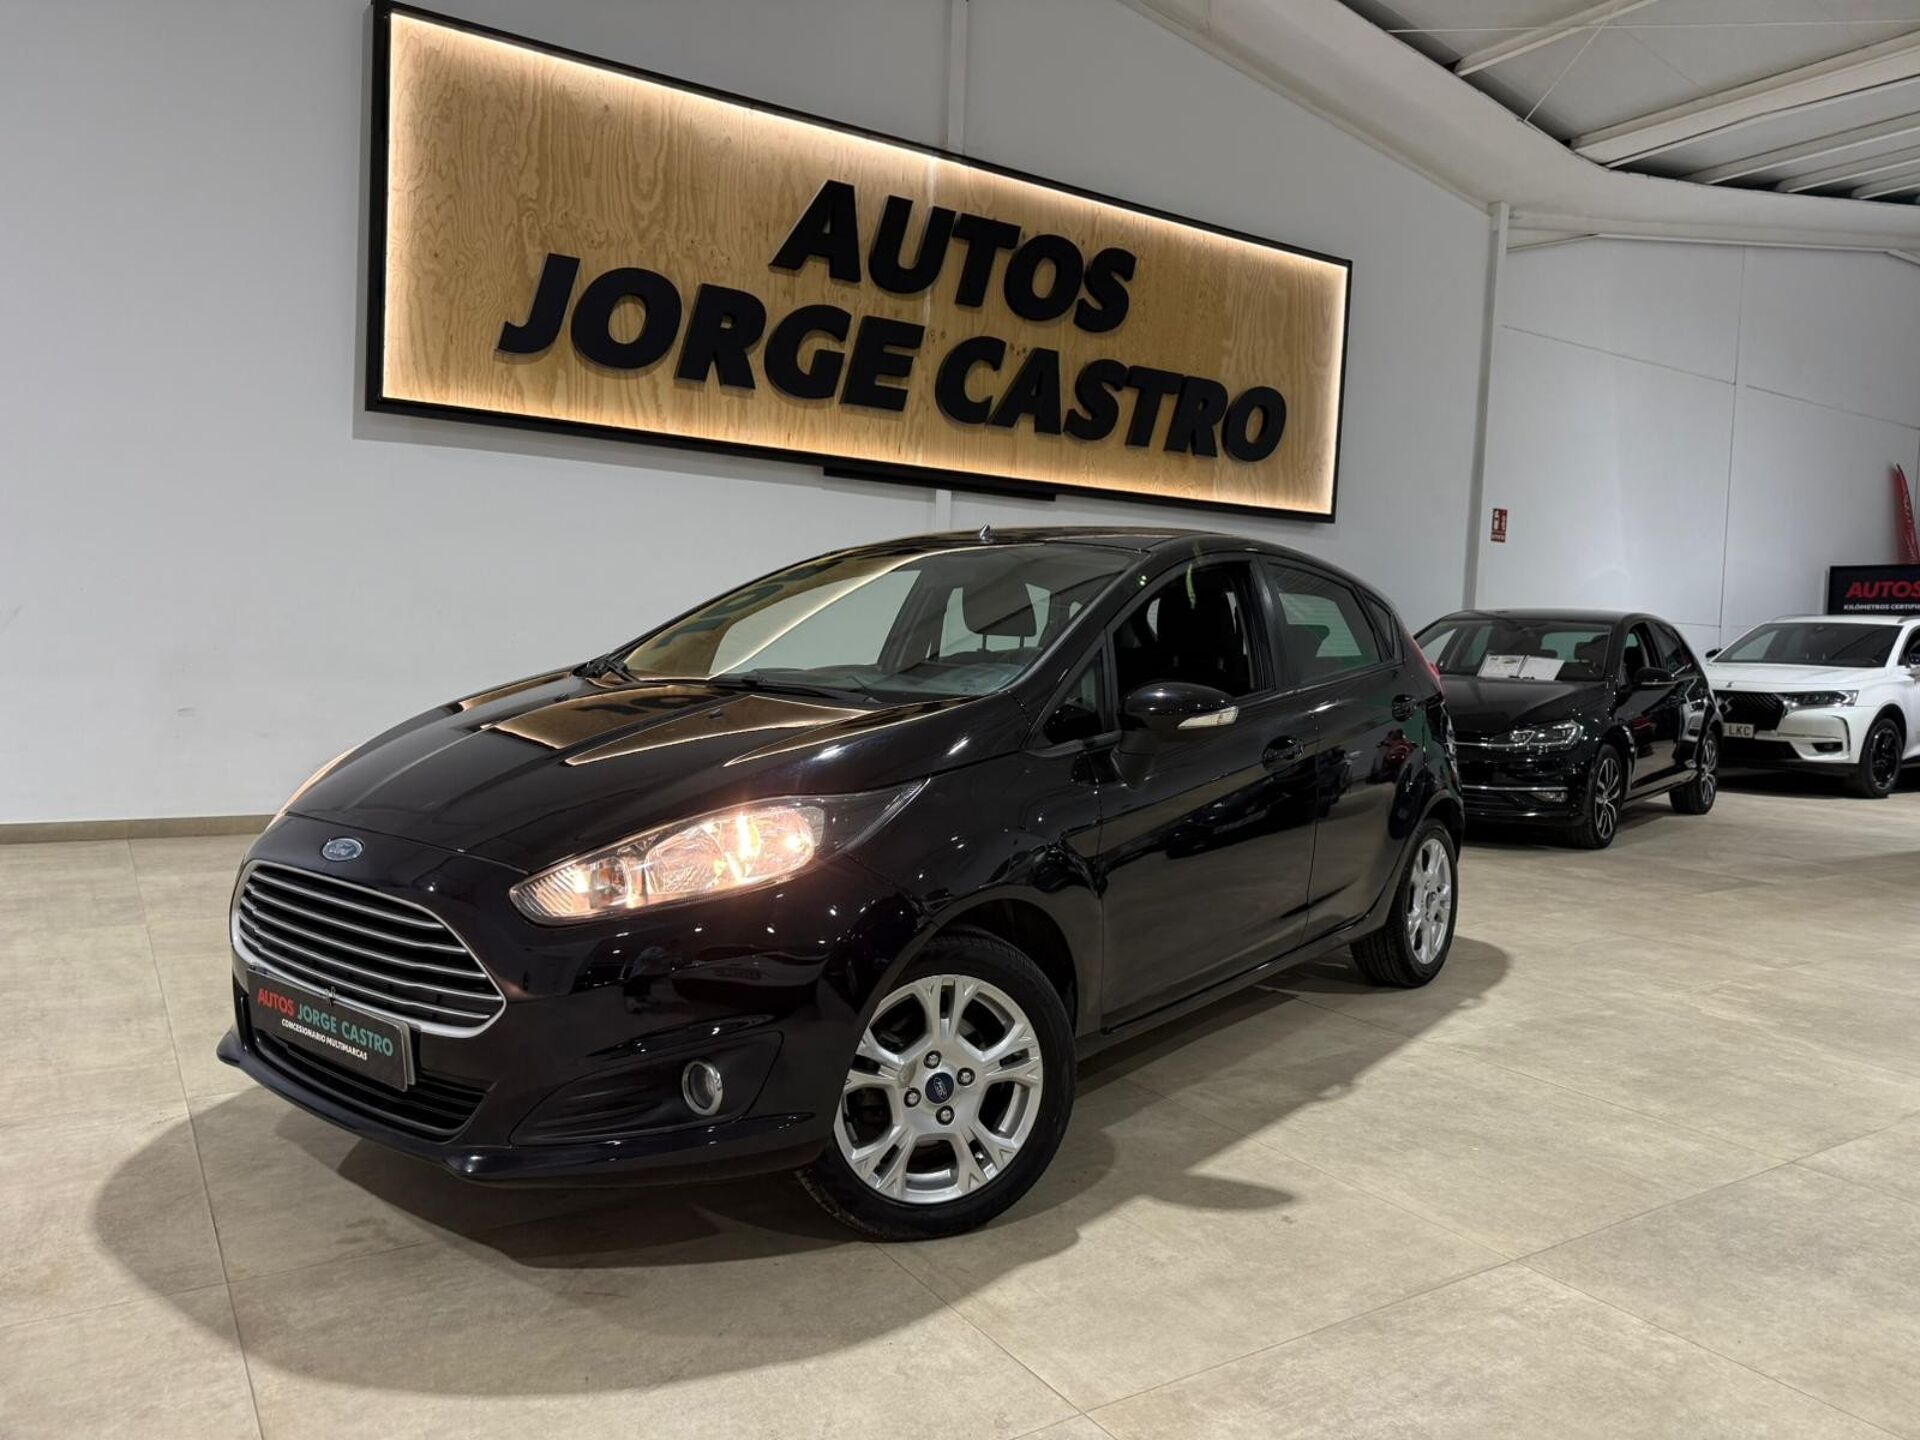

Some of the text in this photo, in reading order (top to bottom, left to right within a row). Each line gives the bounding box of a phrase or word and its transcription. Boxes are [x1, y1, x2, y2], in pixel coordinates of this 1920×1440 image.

[768, 179, 1136, 333] AUTOS
[496, 252, 1287, 463] JORGE CASTRO
[1846, 581, 1920, 598] AUTOS
[1728, 724, 1751, 737] LKC
[257, 987, 394, 1057] AUTOS JORGE CASTRO
[281, 1017, 368, 1062] CONCESIONARIO MULTIMARCAS
